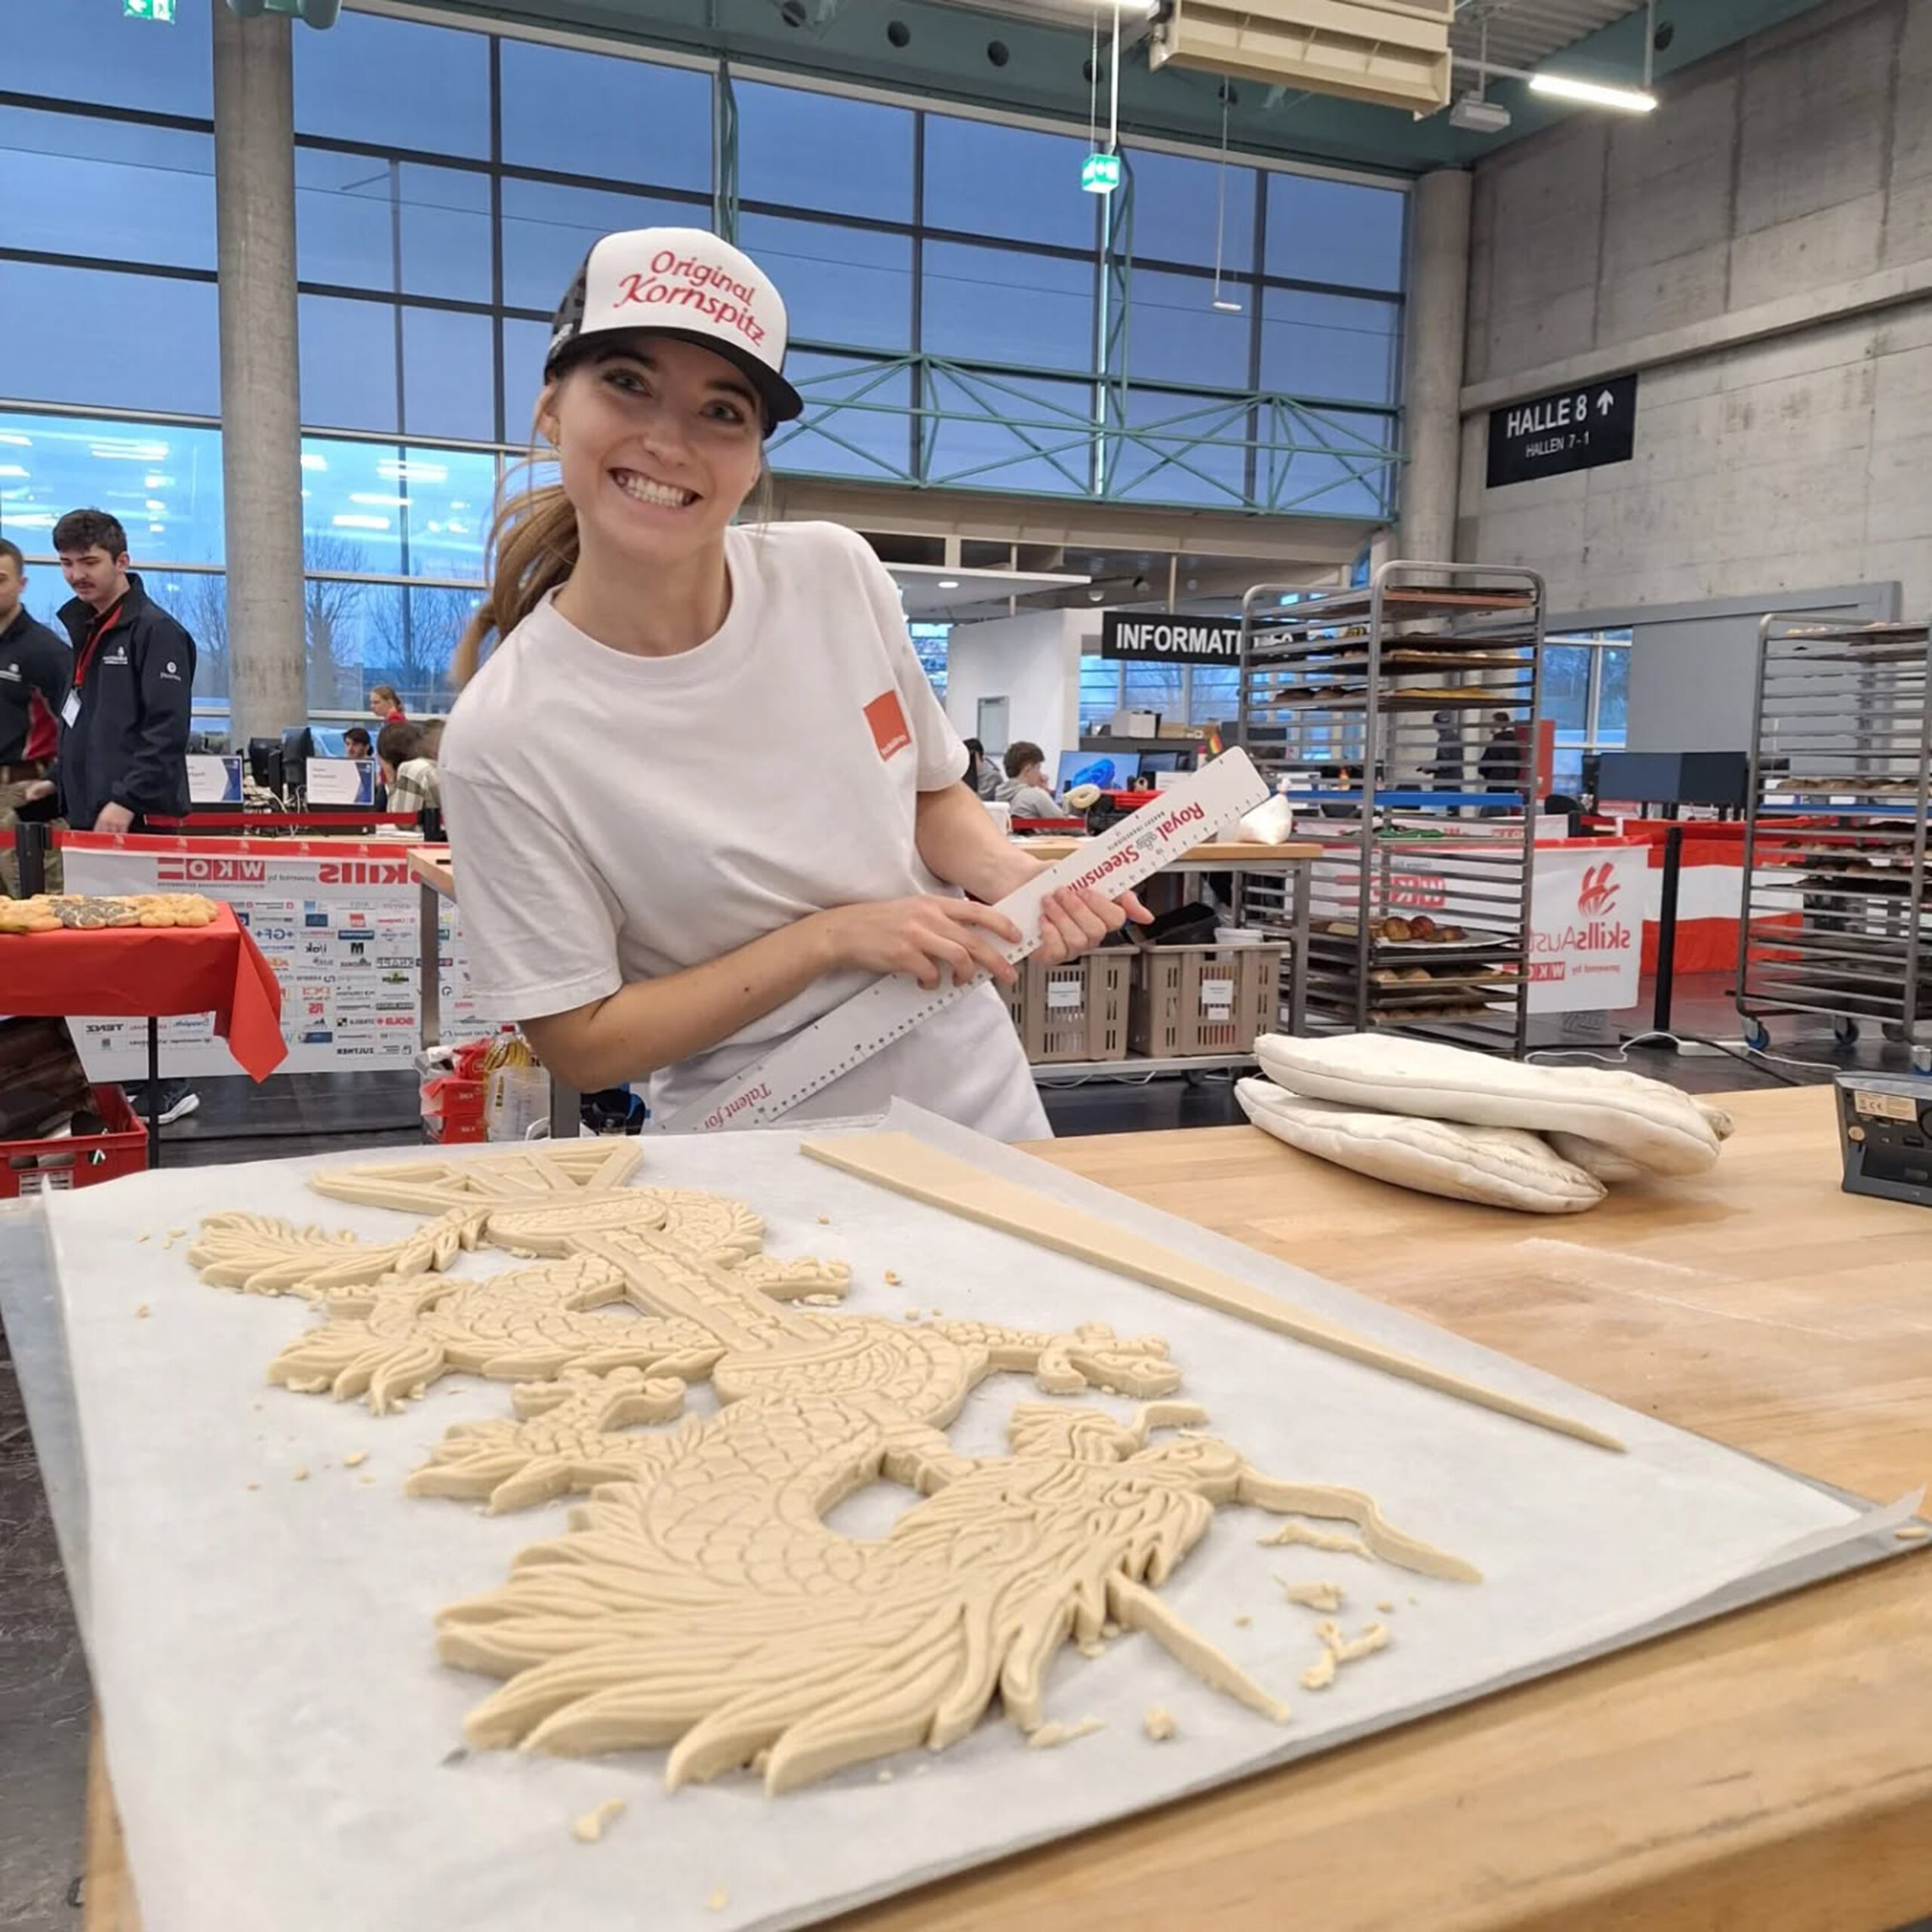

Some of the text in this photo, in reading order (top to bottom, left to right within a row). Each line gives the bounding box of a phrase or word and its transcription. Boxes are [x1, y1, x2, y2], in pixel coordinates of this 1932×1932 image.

[651, 250, 756, 306] Original
[613, 273, 765, 347] Kornspitz
[1506, 394, 1587, 438] HALLE 8
[1525, 436, 1564, 458] HALLEN
[1115, 623, 1275, 656] INFORMATI
[1068, 801, 1205, 892] Royal Steensm
[724, 1082, 771, 1117] Talent
